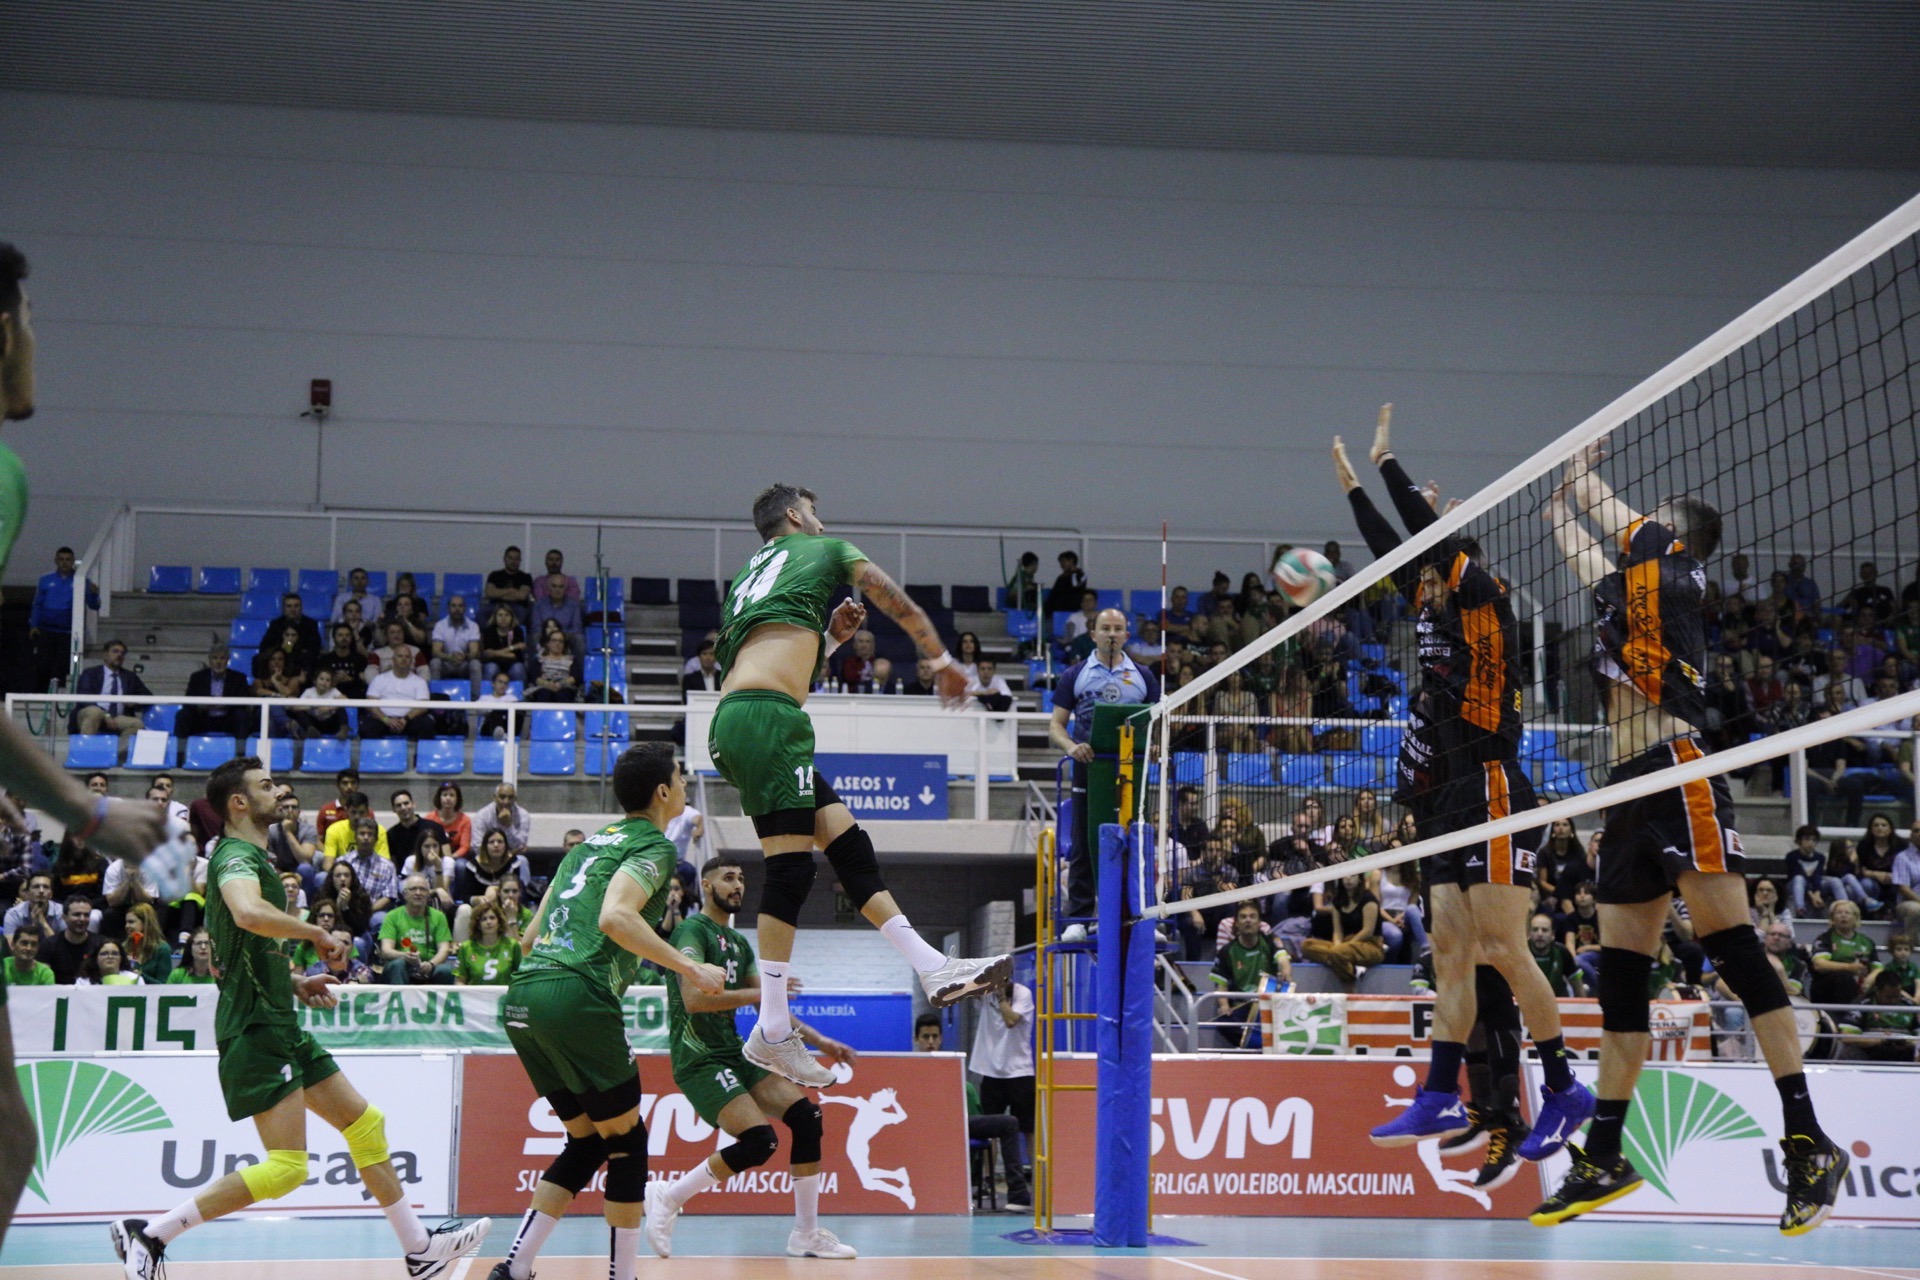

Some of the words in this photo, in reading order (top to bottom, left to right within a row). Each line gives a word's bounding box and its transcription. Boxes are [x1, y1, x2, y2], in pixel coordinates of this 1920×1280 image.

[733, 550, 789, 616] 14
[794, 765, 814, 789] 14
[832, 776, 881, 791] ASEOS
[886, 777, 896, 791] Y
[840, 796, 911, 810] TUARIOS
[559, 855, 599, 899] 5
[280, 1064, 293, 1083] 1
[715, 1068, 738, 1088] 15
[1151, 1097, 1314, 1160] VM
[1213, 1173, 1302, 1195] VOLEIBOL
[1306, 1172, 1415, 1195] MASCULINA
